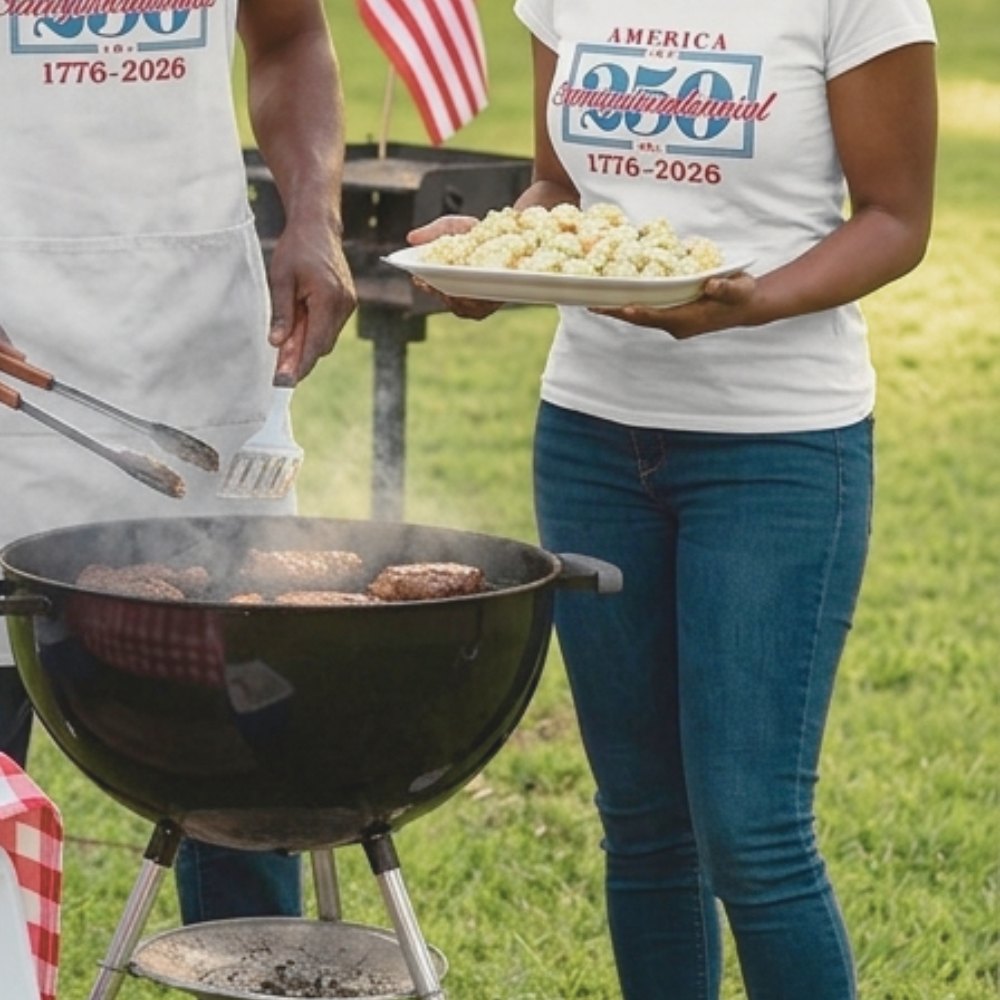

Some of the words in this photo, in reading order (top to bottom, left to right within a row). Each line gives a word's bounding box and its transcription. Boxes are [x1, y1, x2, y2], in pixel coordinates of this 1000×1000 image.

[607, 27, 727, 50] AMERICA
[43, 57, 186, 84] 1776-2026
[580, 63, 733, 141] 250
[588, 153, 722, 184] 1776-2026
